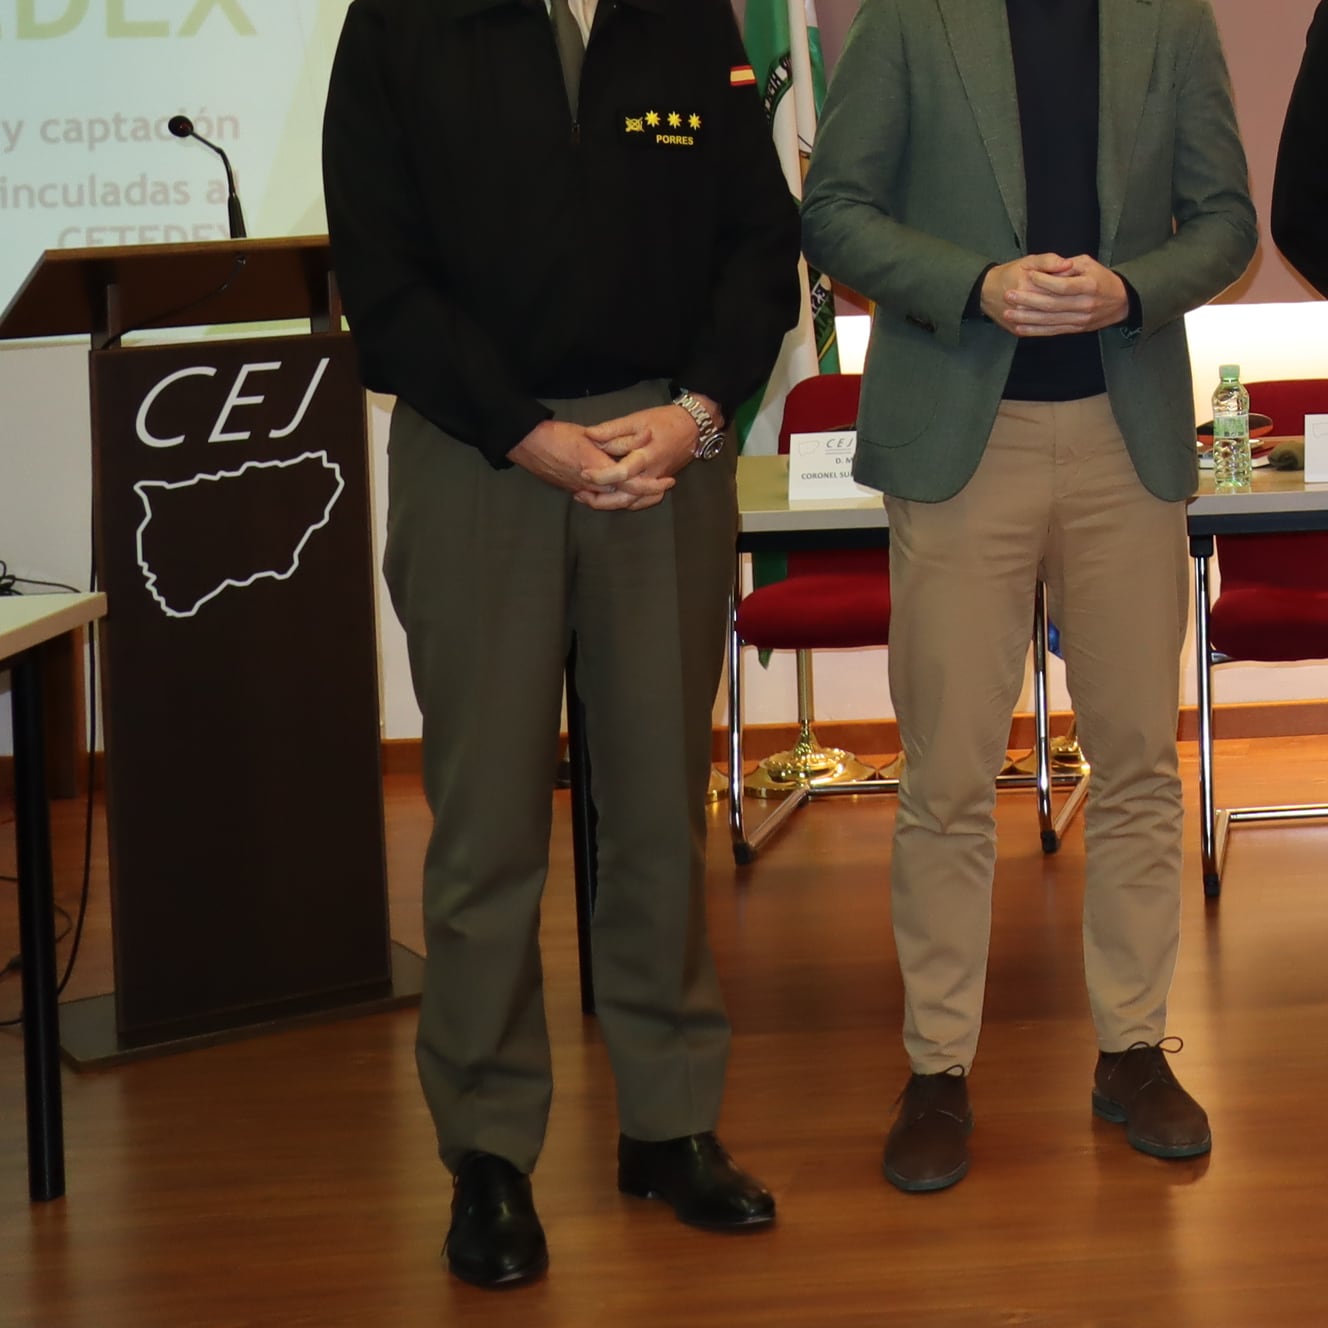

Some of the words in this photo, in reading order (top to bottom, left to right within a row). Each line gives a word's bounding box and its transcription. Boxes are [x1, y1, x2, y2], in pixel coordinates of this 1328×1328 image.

[40, 108, 240, 151] captacón
[656, 134, 694, 146] PORRES
[135, 357, 330, 448] CEJ
